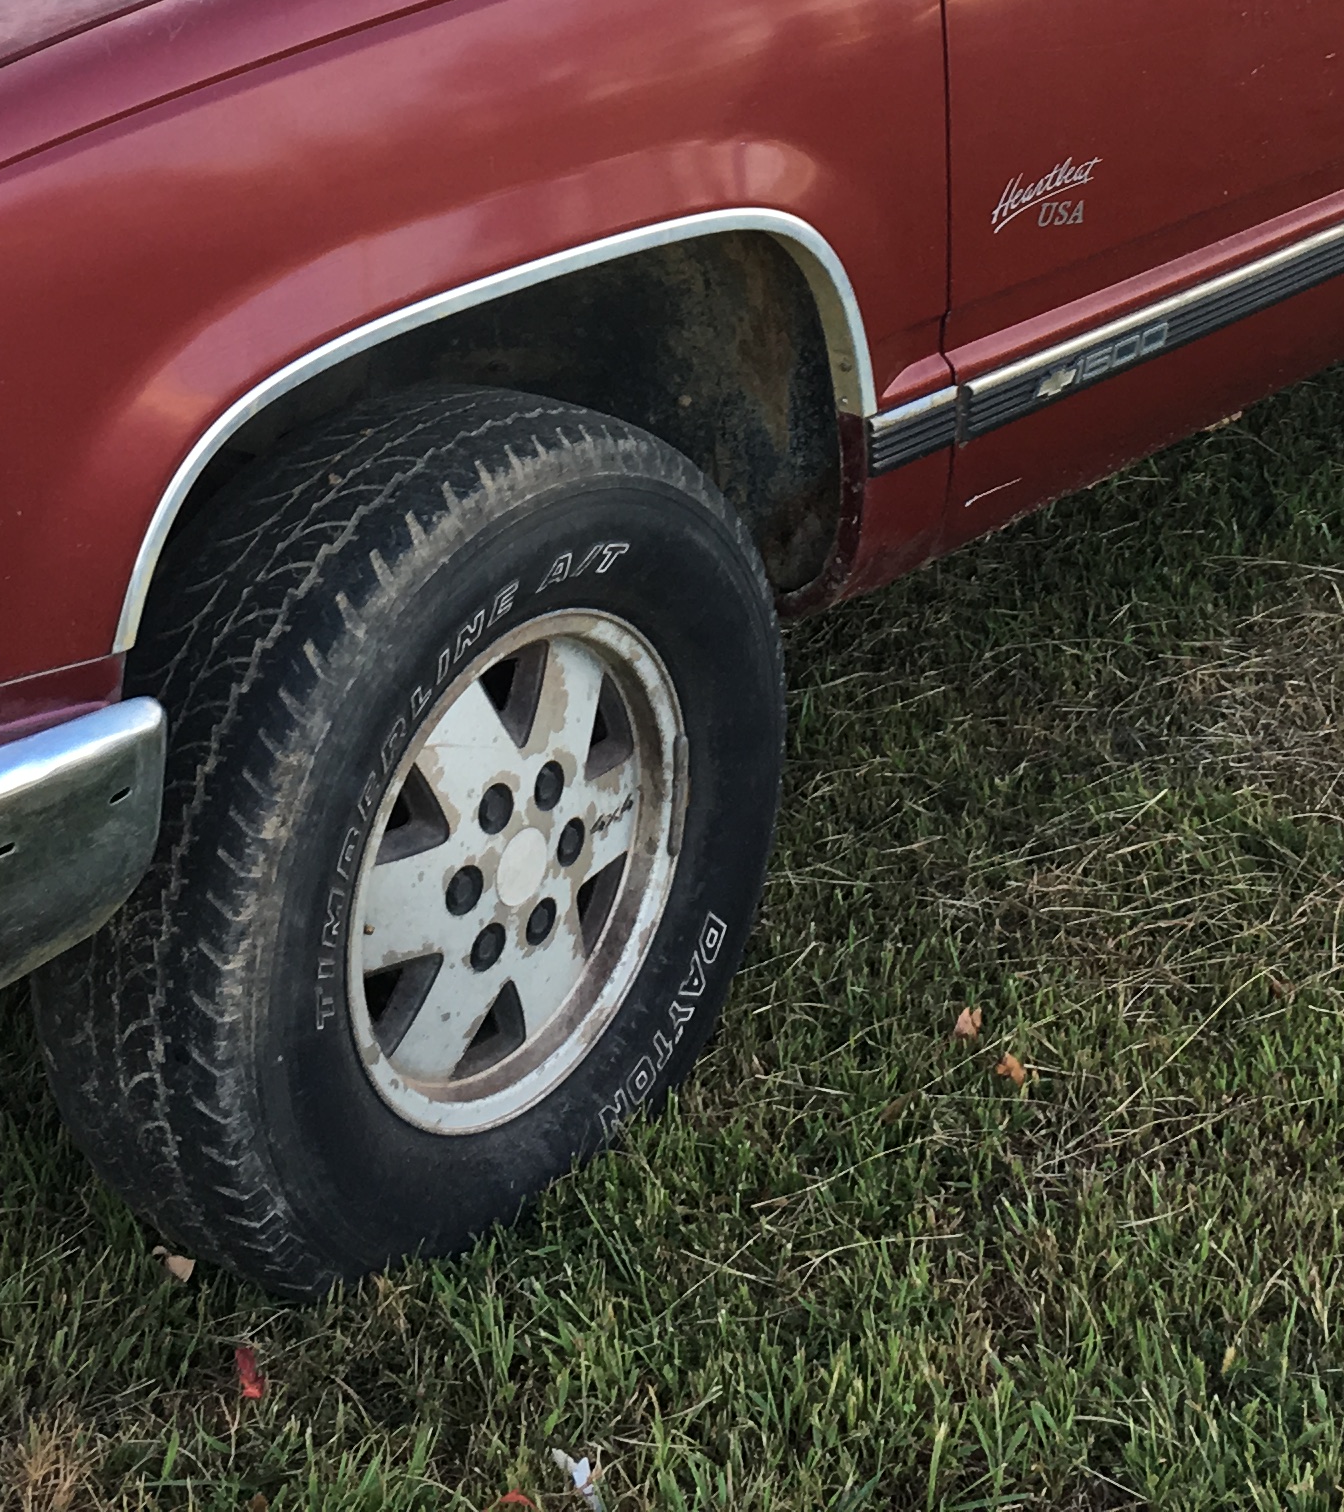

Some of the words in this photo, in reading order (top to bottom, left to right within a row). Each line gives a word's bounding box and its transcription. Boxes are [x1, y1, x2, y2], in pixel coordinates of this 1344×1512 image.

[991, 156, 1103, 226] Heartbeat
[1037, 199, 1086, 228] USA
[534, 542, 630, 594] A/T
[598, 910, 728, 1140] DAYTON
